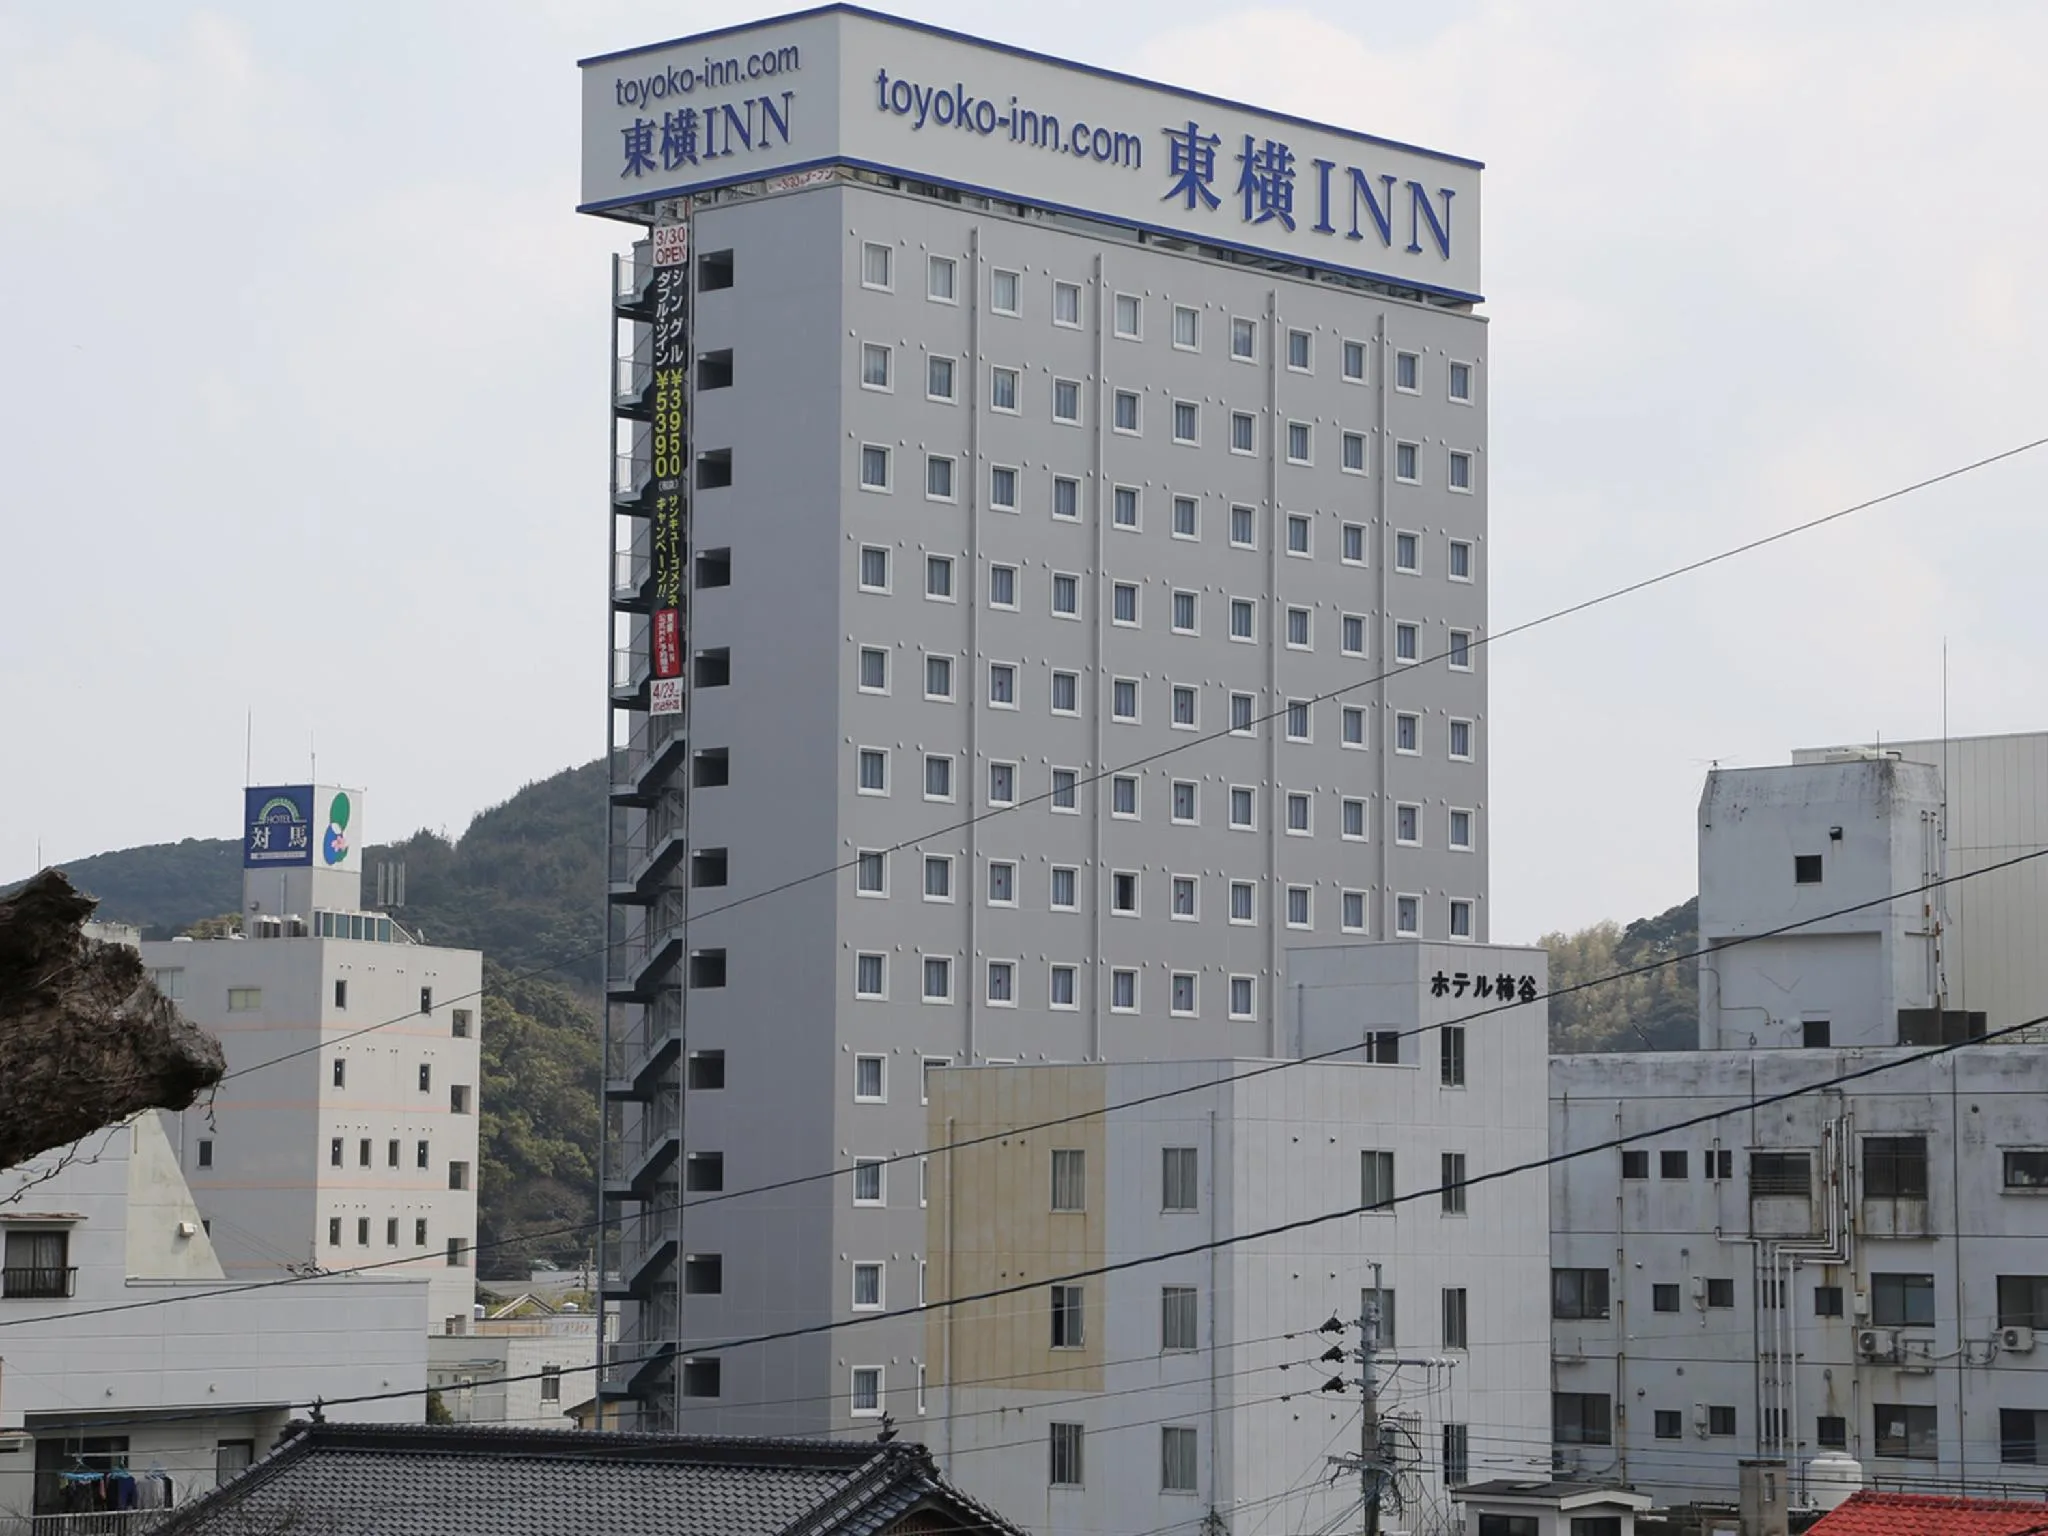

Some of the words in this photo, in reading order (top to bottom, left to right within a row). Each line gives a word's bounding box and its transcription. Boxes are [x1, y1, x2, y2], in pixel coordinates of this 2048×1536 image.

[616, 45, 799, 110] toyoko-inn.com
[620, 91, 795, 179] 東横INN
[875, 68, 1142, 169] toyoko-inn.com
[1162, 120, 1456, 261] 東横INN
[655, 245, 686, 265] OPEN
[656, 226, 686, 246] 3/30
[670, 269, 684, 363] シングル
[251, 825, 307, 849] 対馬
[267, 815, 291, 824] HOTEL
[1431, 970, 1537, 1003] ホテル柿谷
